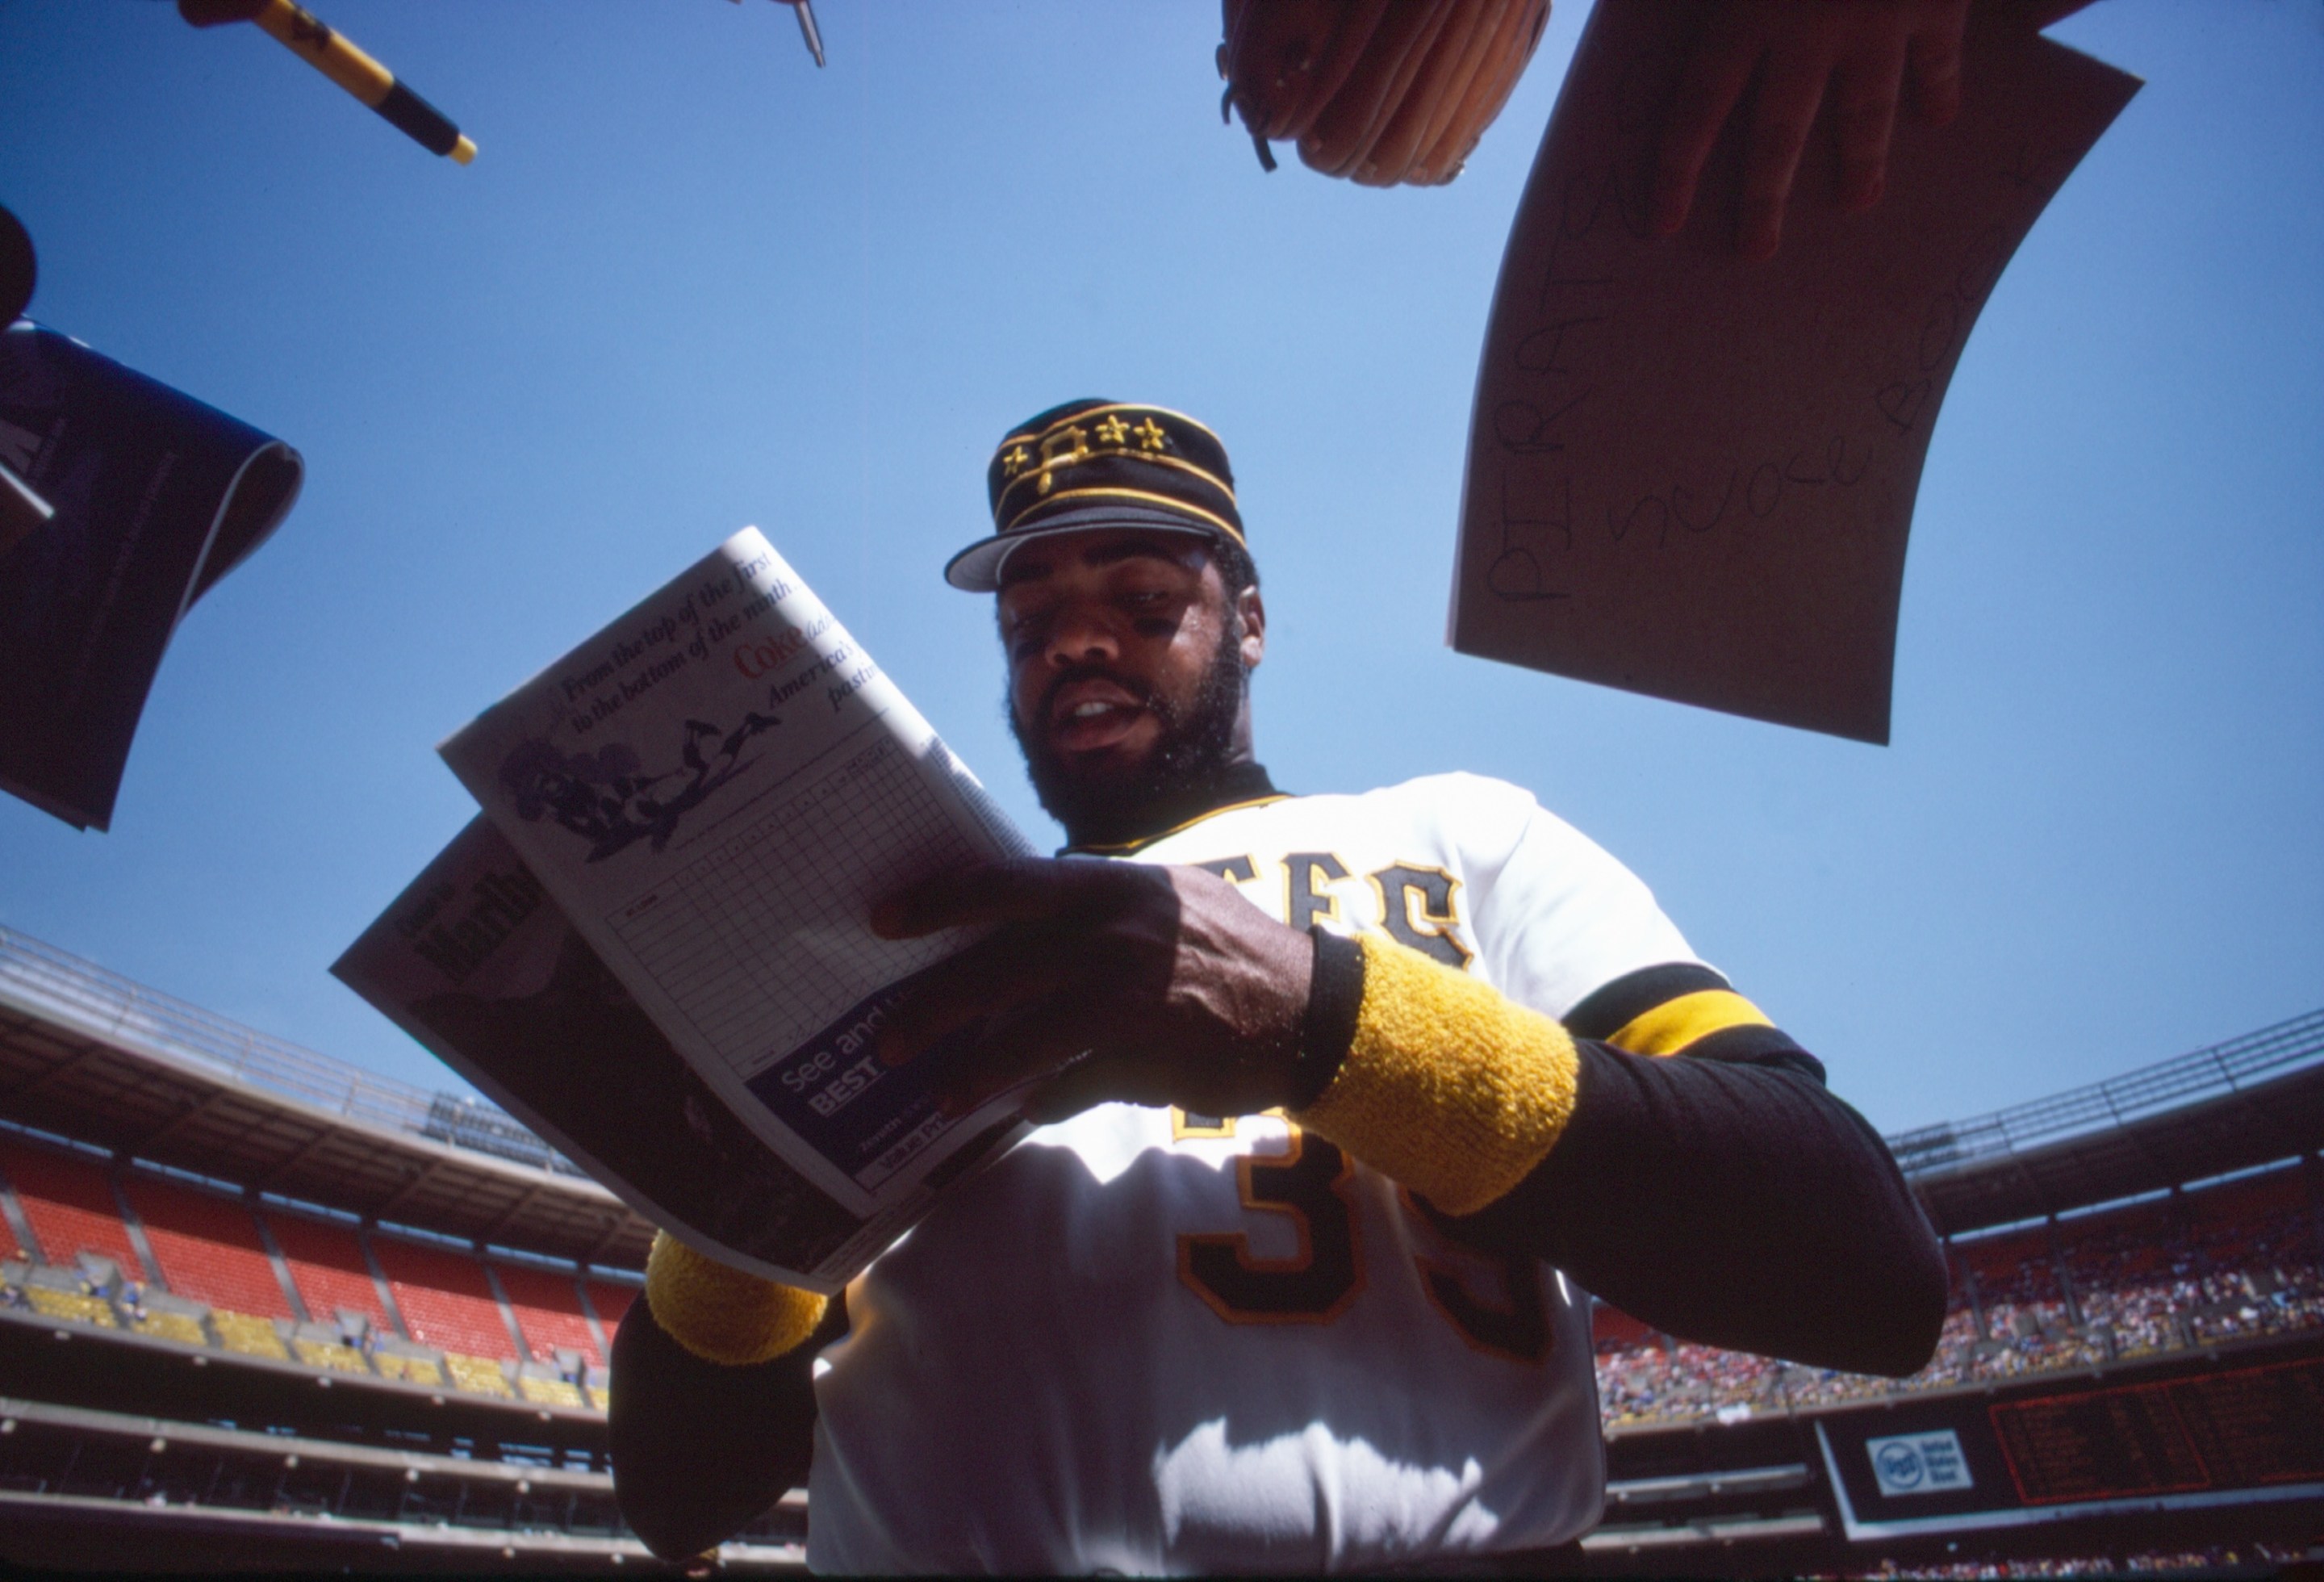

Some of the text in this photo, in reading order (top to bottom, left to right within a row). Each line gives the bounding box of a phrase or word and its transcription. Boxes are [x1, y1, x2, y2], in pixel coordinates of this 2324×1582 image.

[1038, 425, 1089, 496] P
[562, 552, 771, 702] From the top of the first
[734, 626, 808, 679] Coke
[572, 707, 594, 734] to
[591, 697, 623, 721] the
[619, 651, 687, 701] bottom
[688, 628, 708, 661] of
[708, 615, 741, 642] the
[769, 640, 854, 710] America's
[781, 1006, 886, 1093] See and
[808, 1055, 880, 1115] BEST
[878, 1134, 924, 1170] Value
